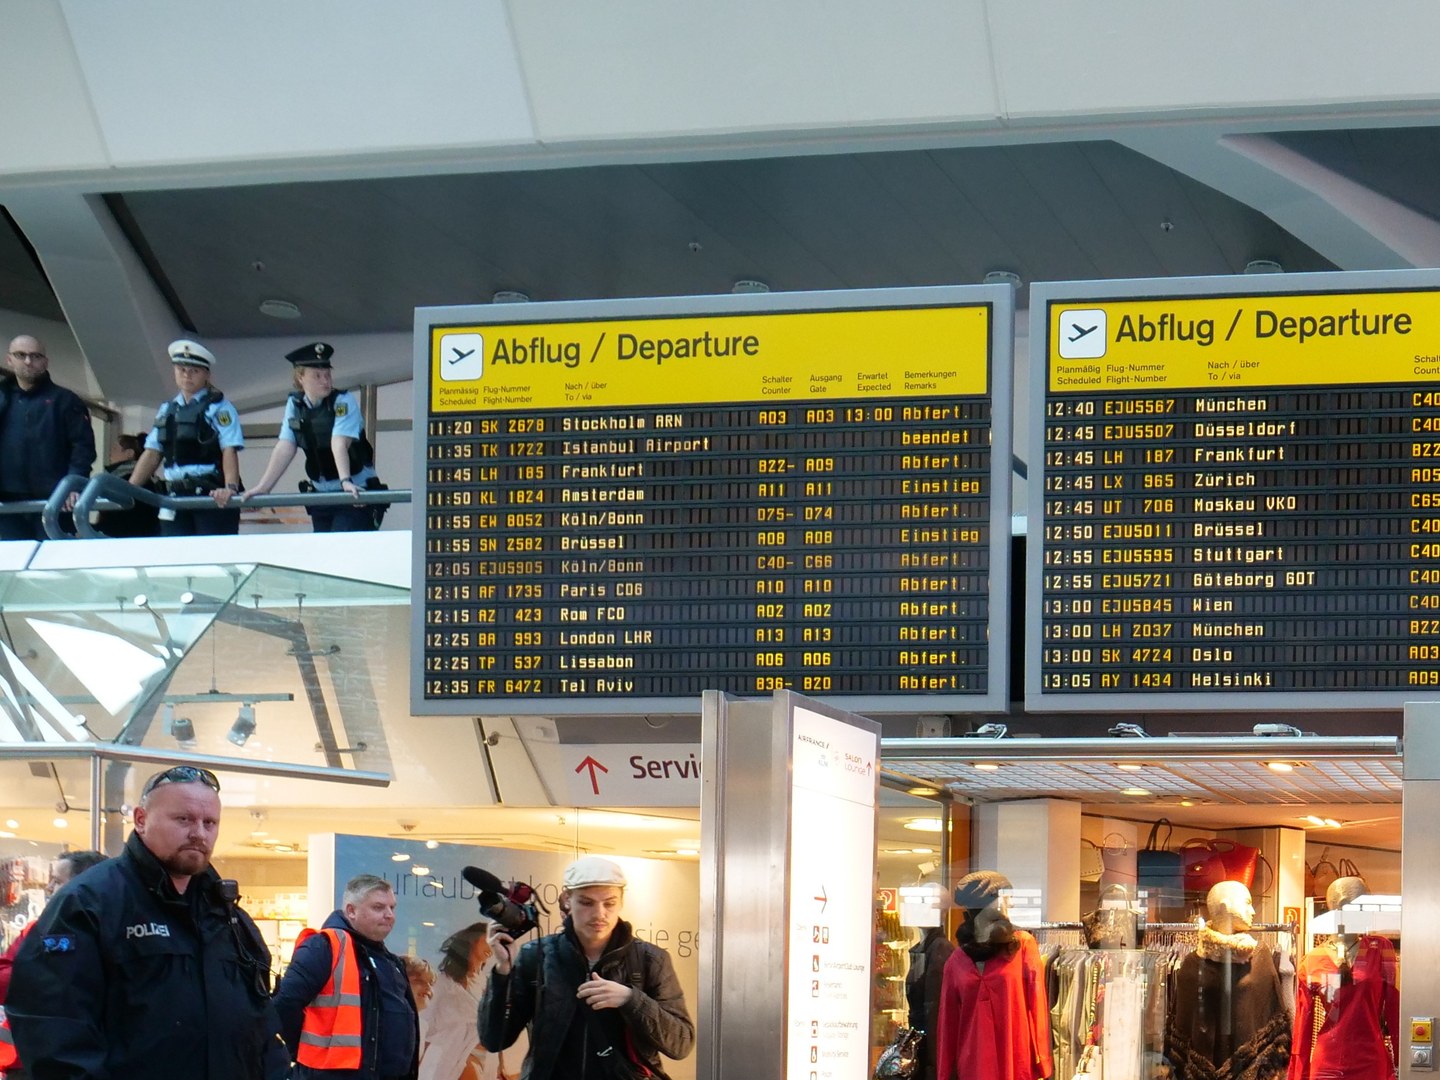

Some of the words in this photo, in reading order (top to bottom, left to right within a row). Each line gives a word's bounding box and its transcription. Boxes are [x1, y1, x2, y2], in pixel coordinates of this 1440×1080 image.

[1115, 313, 1214, 347] Abflug
[1255, 308, 1412, 344] Departure
[490, 336, 580, 369] Abflug
[617, 331, 760, 366] Departure
[1106, 363, 1165, 374] Flug-Nummer
[1207, 360, 1230, 369] Nach
[1240, 360, 1260, 369] über
[1057, 375, 1102, 385] Scheduled
[1106, 374, 1168, 385] Flight-Number
[1207, 372, 1219, 381] To
[1228, 371, 1241, 380] via
[1048, 401, 1094, 416] 12:40
[1195, 397, 1267, 412] München
[563, 415, 645, 431] Stockholm
[1047, 426, 1094, 441] 12:45
[1195, 421, 1295, 437] Düsseldorf
[902, 430, 968, 445] beendet
[562, 439, 634, 455] Istanbul
[646, 437, 709, 454] Airport
[1047, 451, 1094, 466] 12:45
[1195, 446, 1284, 462] Frankfurt
[562, 463, 643, 479] Frankfurt
[902, 479, 979, 494] Einstieg
[1047, 475, 1093, 490] 12:45
[1194, 472, 1255, 487] Zürich
[562, 487, 644, 502] Amsterdam
[1046, 500, 1093, 515] 12:45
[1194, 497, 1255, 512] Moskau
[561, 511, 644, 526] Köln/Bonn
[901, 528, 979, 543] Einstieg
[1046, 525, 1093, 540] 12:50
[1194, 522, 1263, 537] Brüssel
[561, 535, 624, 550] Brüssel
[1046, 550, 1093, 564] 12:55
[1193, 547, 1283, 563] Stuttgart
[561, 559, 644, 574] Köln/Bonn
[1045, 574, 1092, 589] 12:55
[1193, 572, 1274, 588] Göteborg
[560, 583, 606, 597] Paris
[560, 607, 588, 621] Rom
[1045, 599, 1092, 614] 13:00
[1193, 598, 1233, 612] Wien
[560, 631, 615, 645] London
[624, 630, 652, 644] LHR
[1045, 624, 1092, 638] 13:00
[1193, 622, 1264, 637] München
[560, 655, 633, 669] Lissabon
[1045, 649, 1091, 663] 13:00
[1192, 647, 1232, 662] Oslo
[560, 679, 586, 693] Tel
[597, 678, 633, 692] Aviv
[1044, 673, 1091, 688] 13:05
[1192, 672, 1271, 687] Helsinki
[629, 753, 702, 779] Servi
[126, 922, 170, 939] POLIZEI
